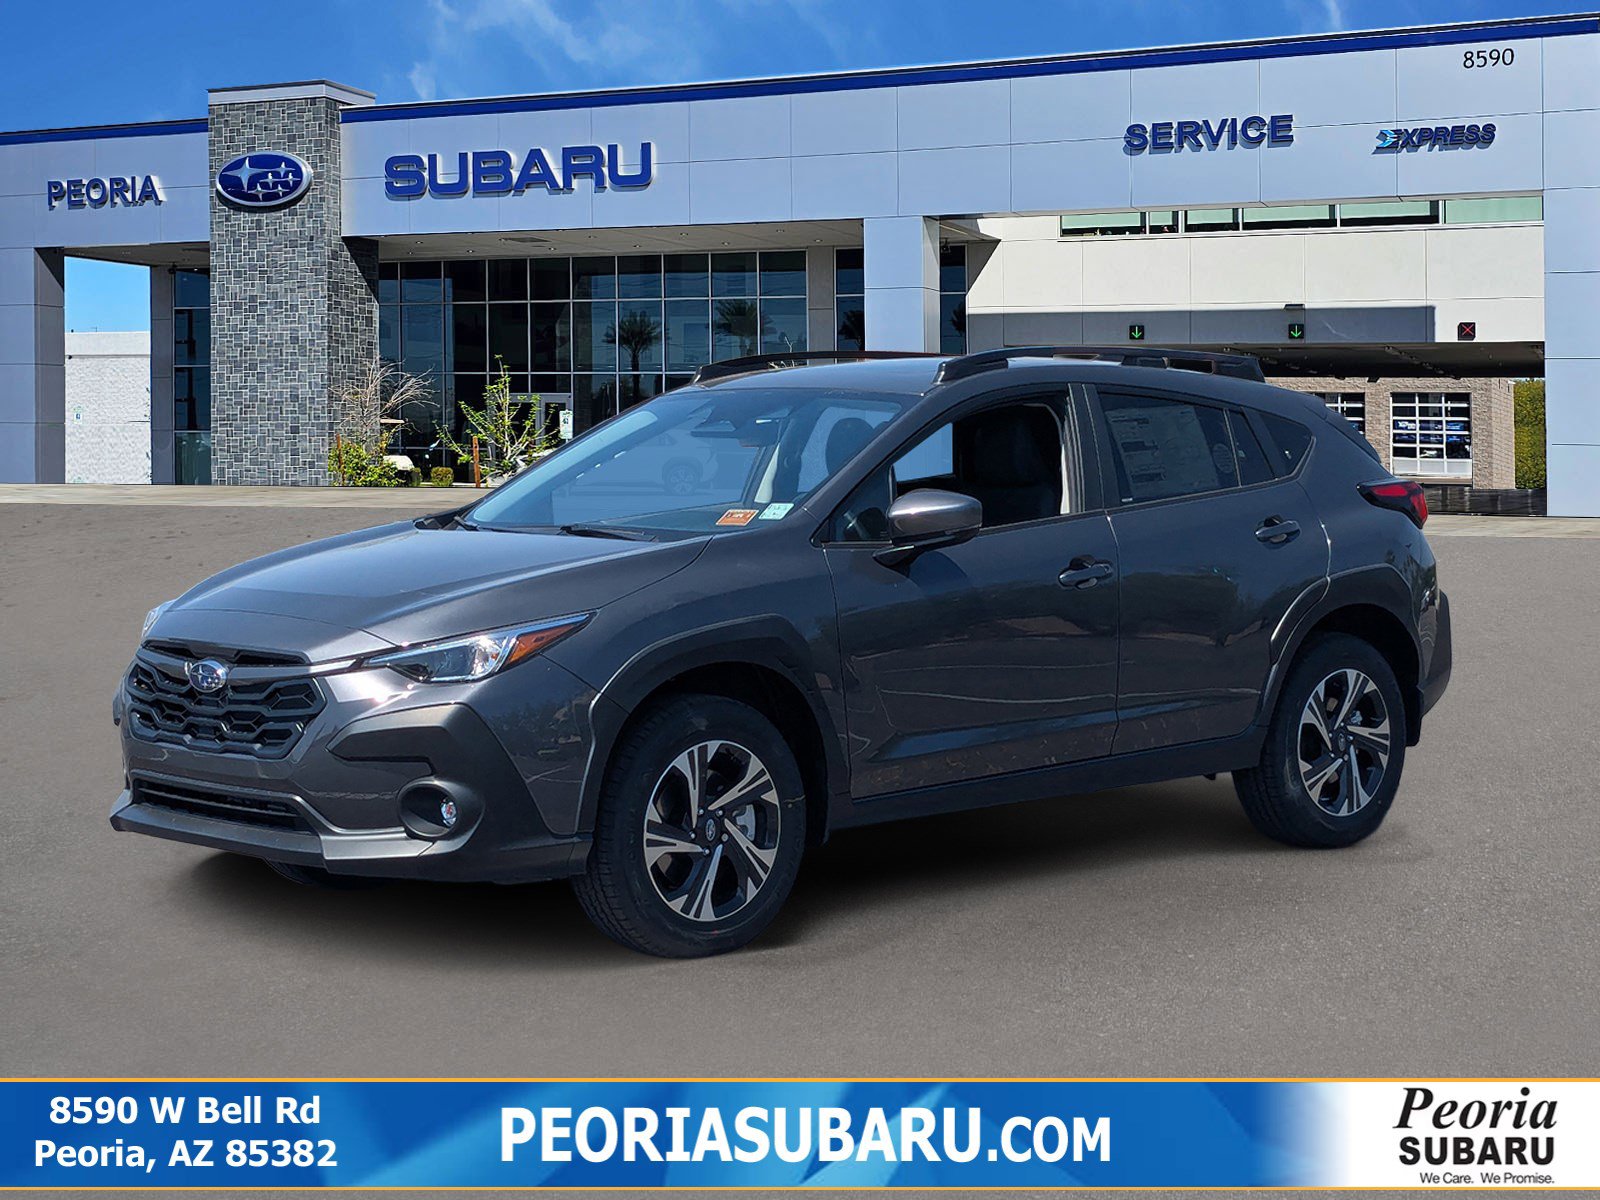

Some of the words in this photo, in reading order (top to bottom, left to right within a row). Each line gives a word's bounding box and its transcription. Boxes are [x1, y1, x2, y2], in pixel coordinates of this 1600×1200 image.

[1463, 48, 1515, 69] 8590
[1124, 114, 1294, 152] SERVICE
[1375, 122, 1497, 150] EXPRESS
[384, 142, 652, 200] SUBARU
[47, 175, 163, 211] PEORIA
